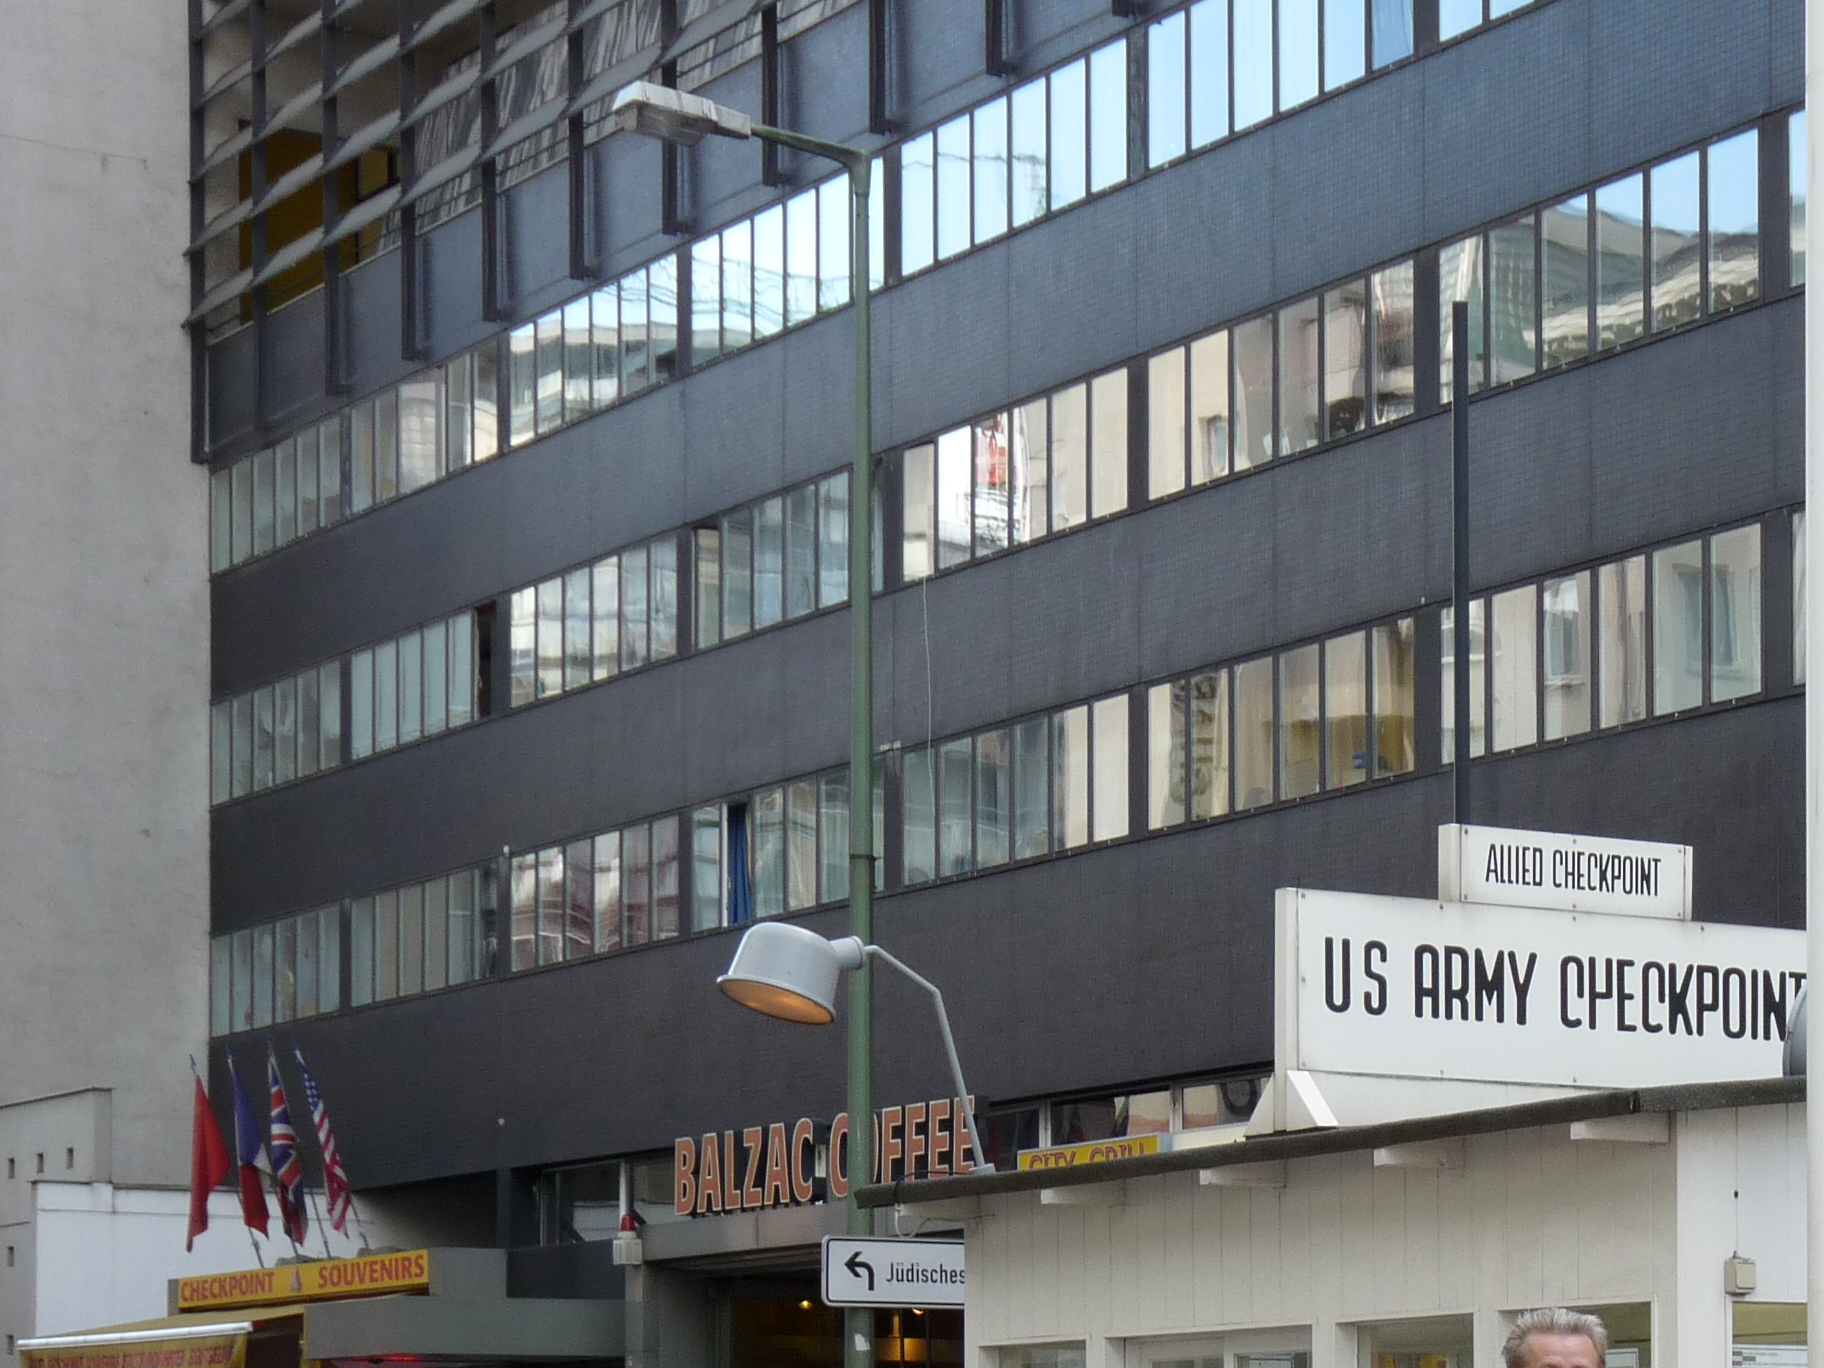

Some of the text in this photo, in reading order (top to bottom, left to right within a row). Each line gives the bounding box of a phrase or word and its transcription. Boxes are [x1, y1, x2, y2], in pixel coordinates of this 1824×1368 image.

[1485, 843, 1662, 897] ALLIED CHECKPOINT
[1414, 943, 1538, 1026] ARMY
[675, 1095, 985, 1216] BALZAC CFFEE
[180, 1253, 426, 1303] CHECKPOINT SOUVENIRS
[886, 1262, 965, 1284] Jüdisches
